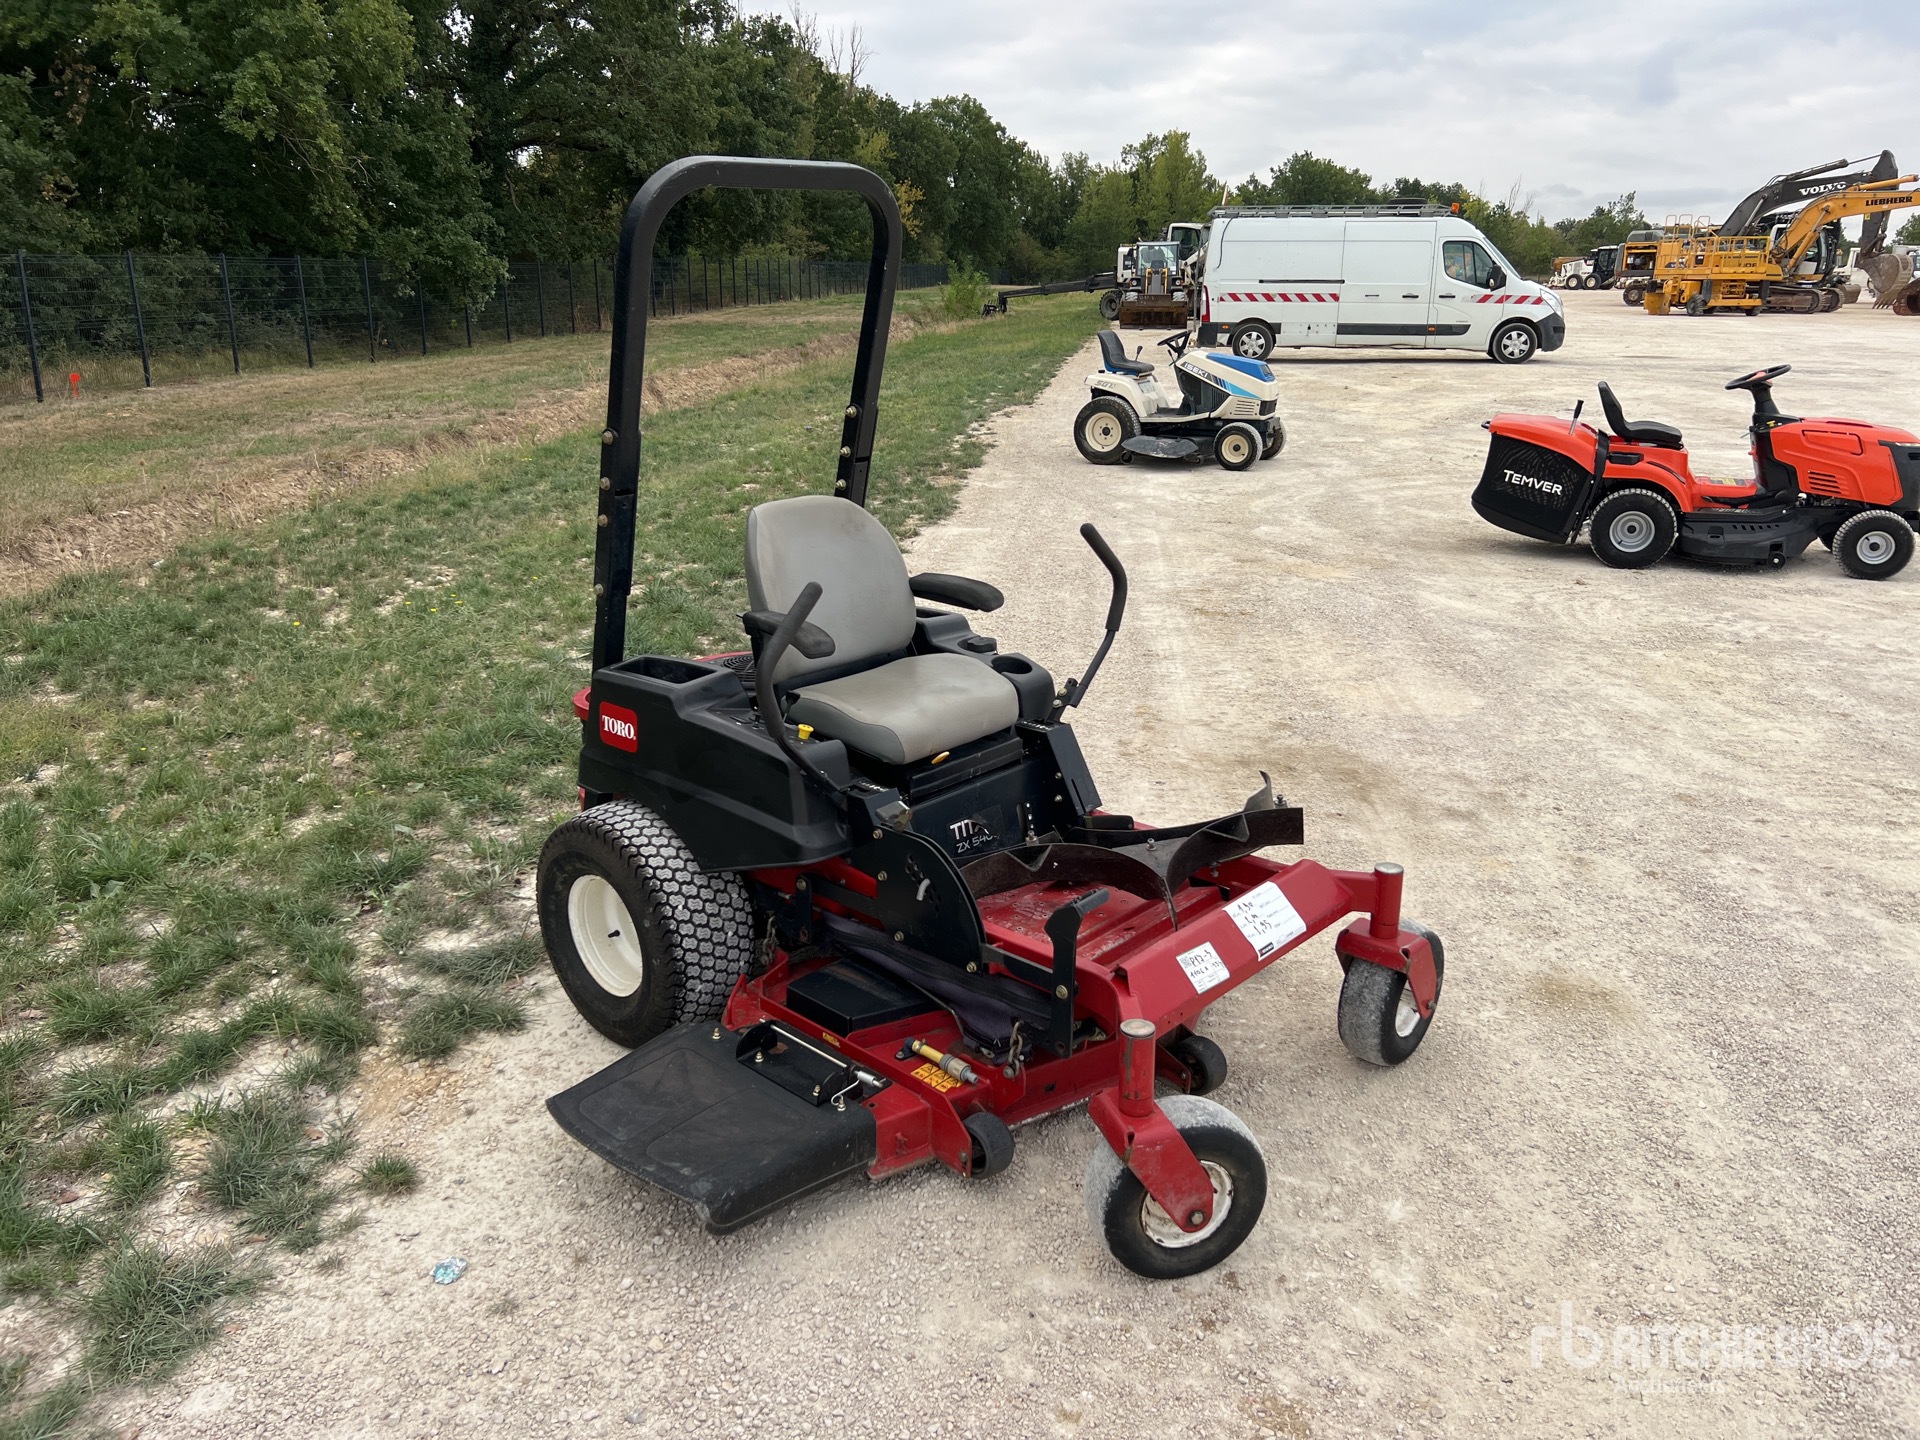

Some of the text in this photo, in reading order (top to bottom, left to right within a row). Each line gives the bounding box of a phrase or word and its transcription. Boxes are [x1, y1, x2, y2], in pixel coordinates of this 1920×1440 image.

[1799, 181, 1847, 196] VOLVO
[1865, 196, 1913, 207] LIEBHERR
[1184, 362, 1208, 378] ISEKI
[1503, 469, 1563, 496] TEMVER
[602, 715, 636, 740] TORO
[949, 819, 990, 841] TITA
[956, 840, 971, 853] ZX
